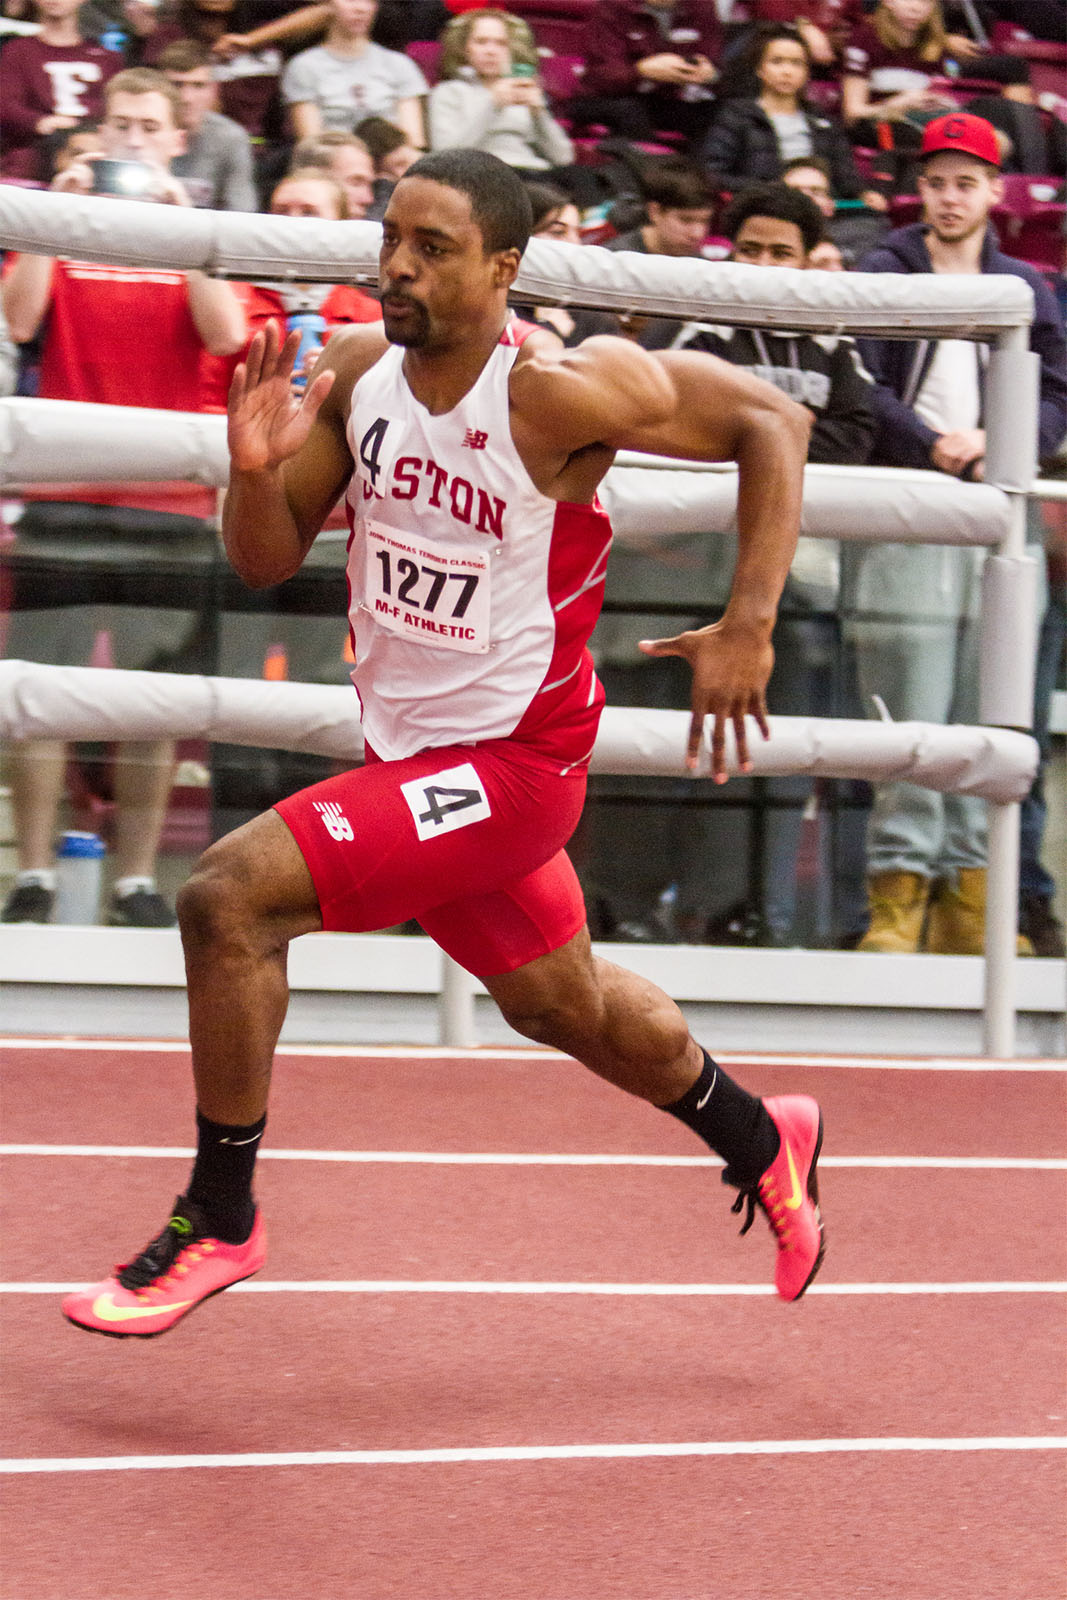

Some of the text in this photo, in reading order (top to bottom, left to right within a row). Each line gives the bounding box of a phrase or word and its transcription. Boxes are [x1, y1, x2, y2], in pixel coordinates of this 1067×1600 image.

[43, 62, 101, 117] F
[360, 417, 389, 486] 4
[362, 456, 507, 541] STON
[368, 530, 487, 570] JOHN THOMAS TERRIER CLASSIC
[376, 549, 479, 619] 1277
[375, 599, 401, 619] M-F
[403, 613, 476, 641] ATHLETIC
[419, 785, 482, 826] 4
